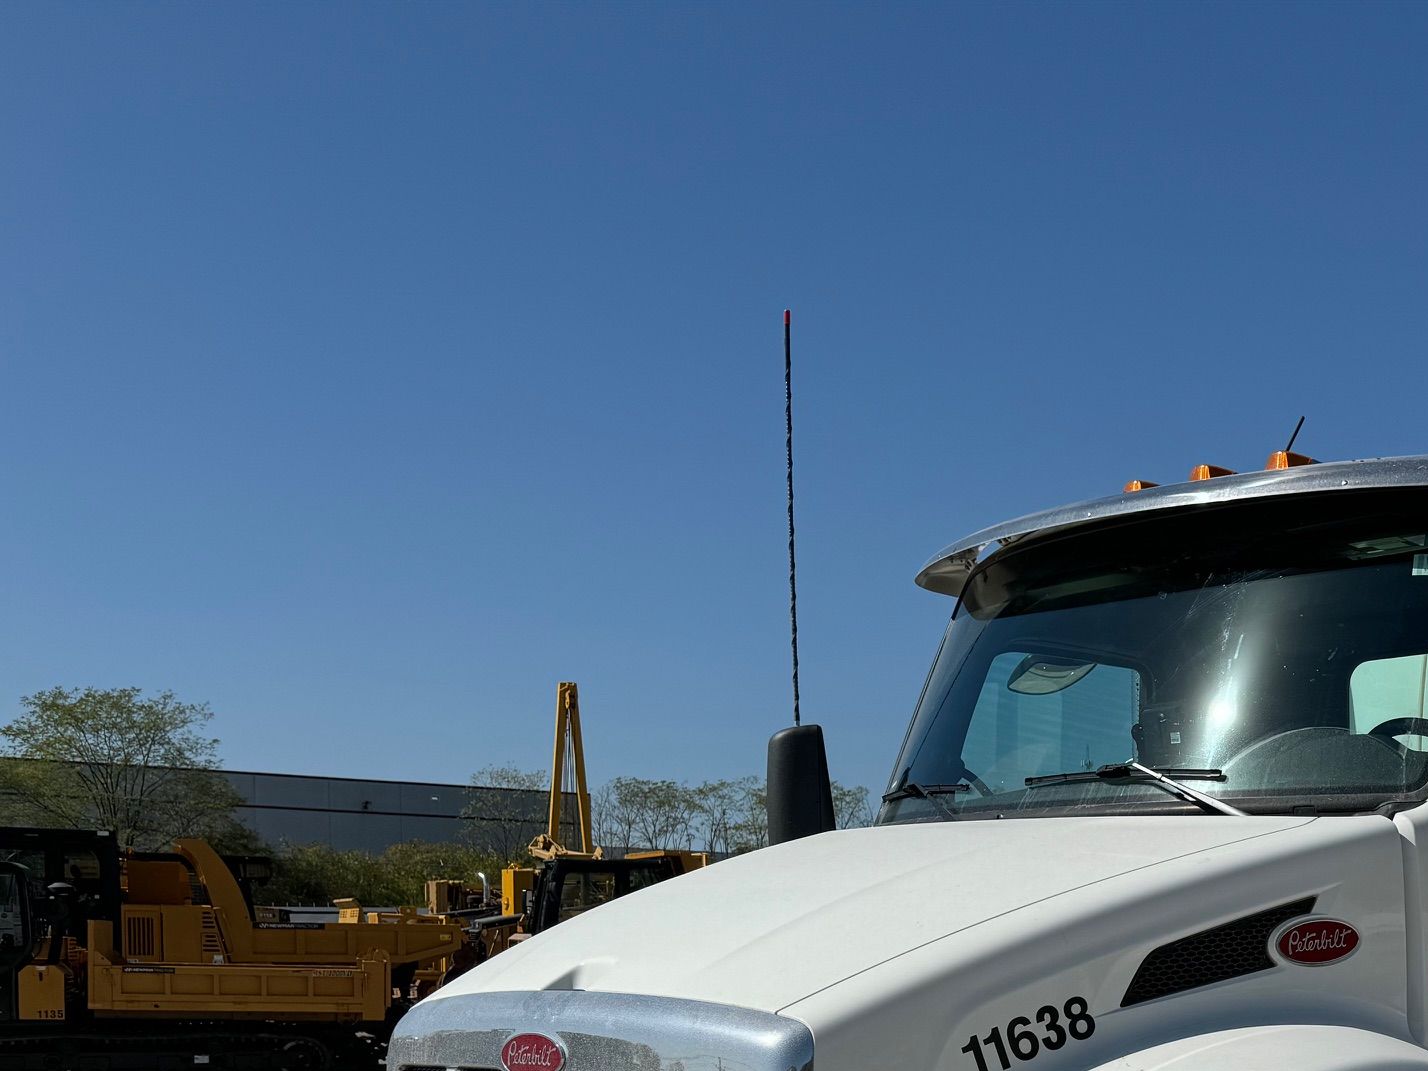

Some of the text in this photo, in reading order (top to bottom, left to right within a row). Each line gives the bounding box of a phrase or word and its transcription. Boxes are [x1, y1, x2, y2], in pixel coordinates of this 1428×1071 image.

[1287, 926, 1352, 955] Peterbilt
[37, 1009, 64, 1019] 1135
[507, 1040, 557, 1067] Peterbilt
